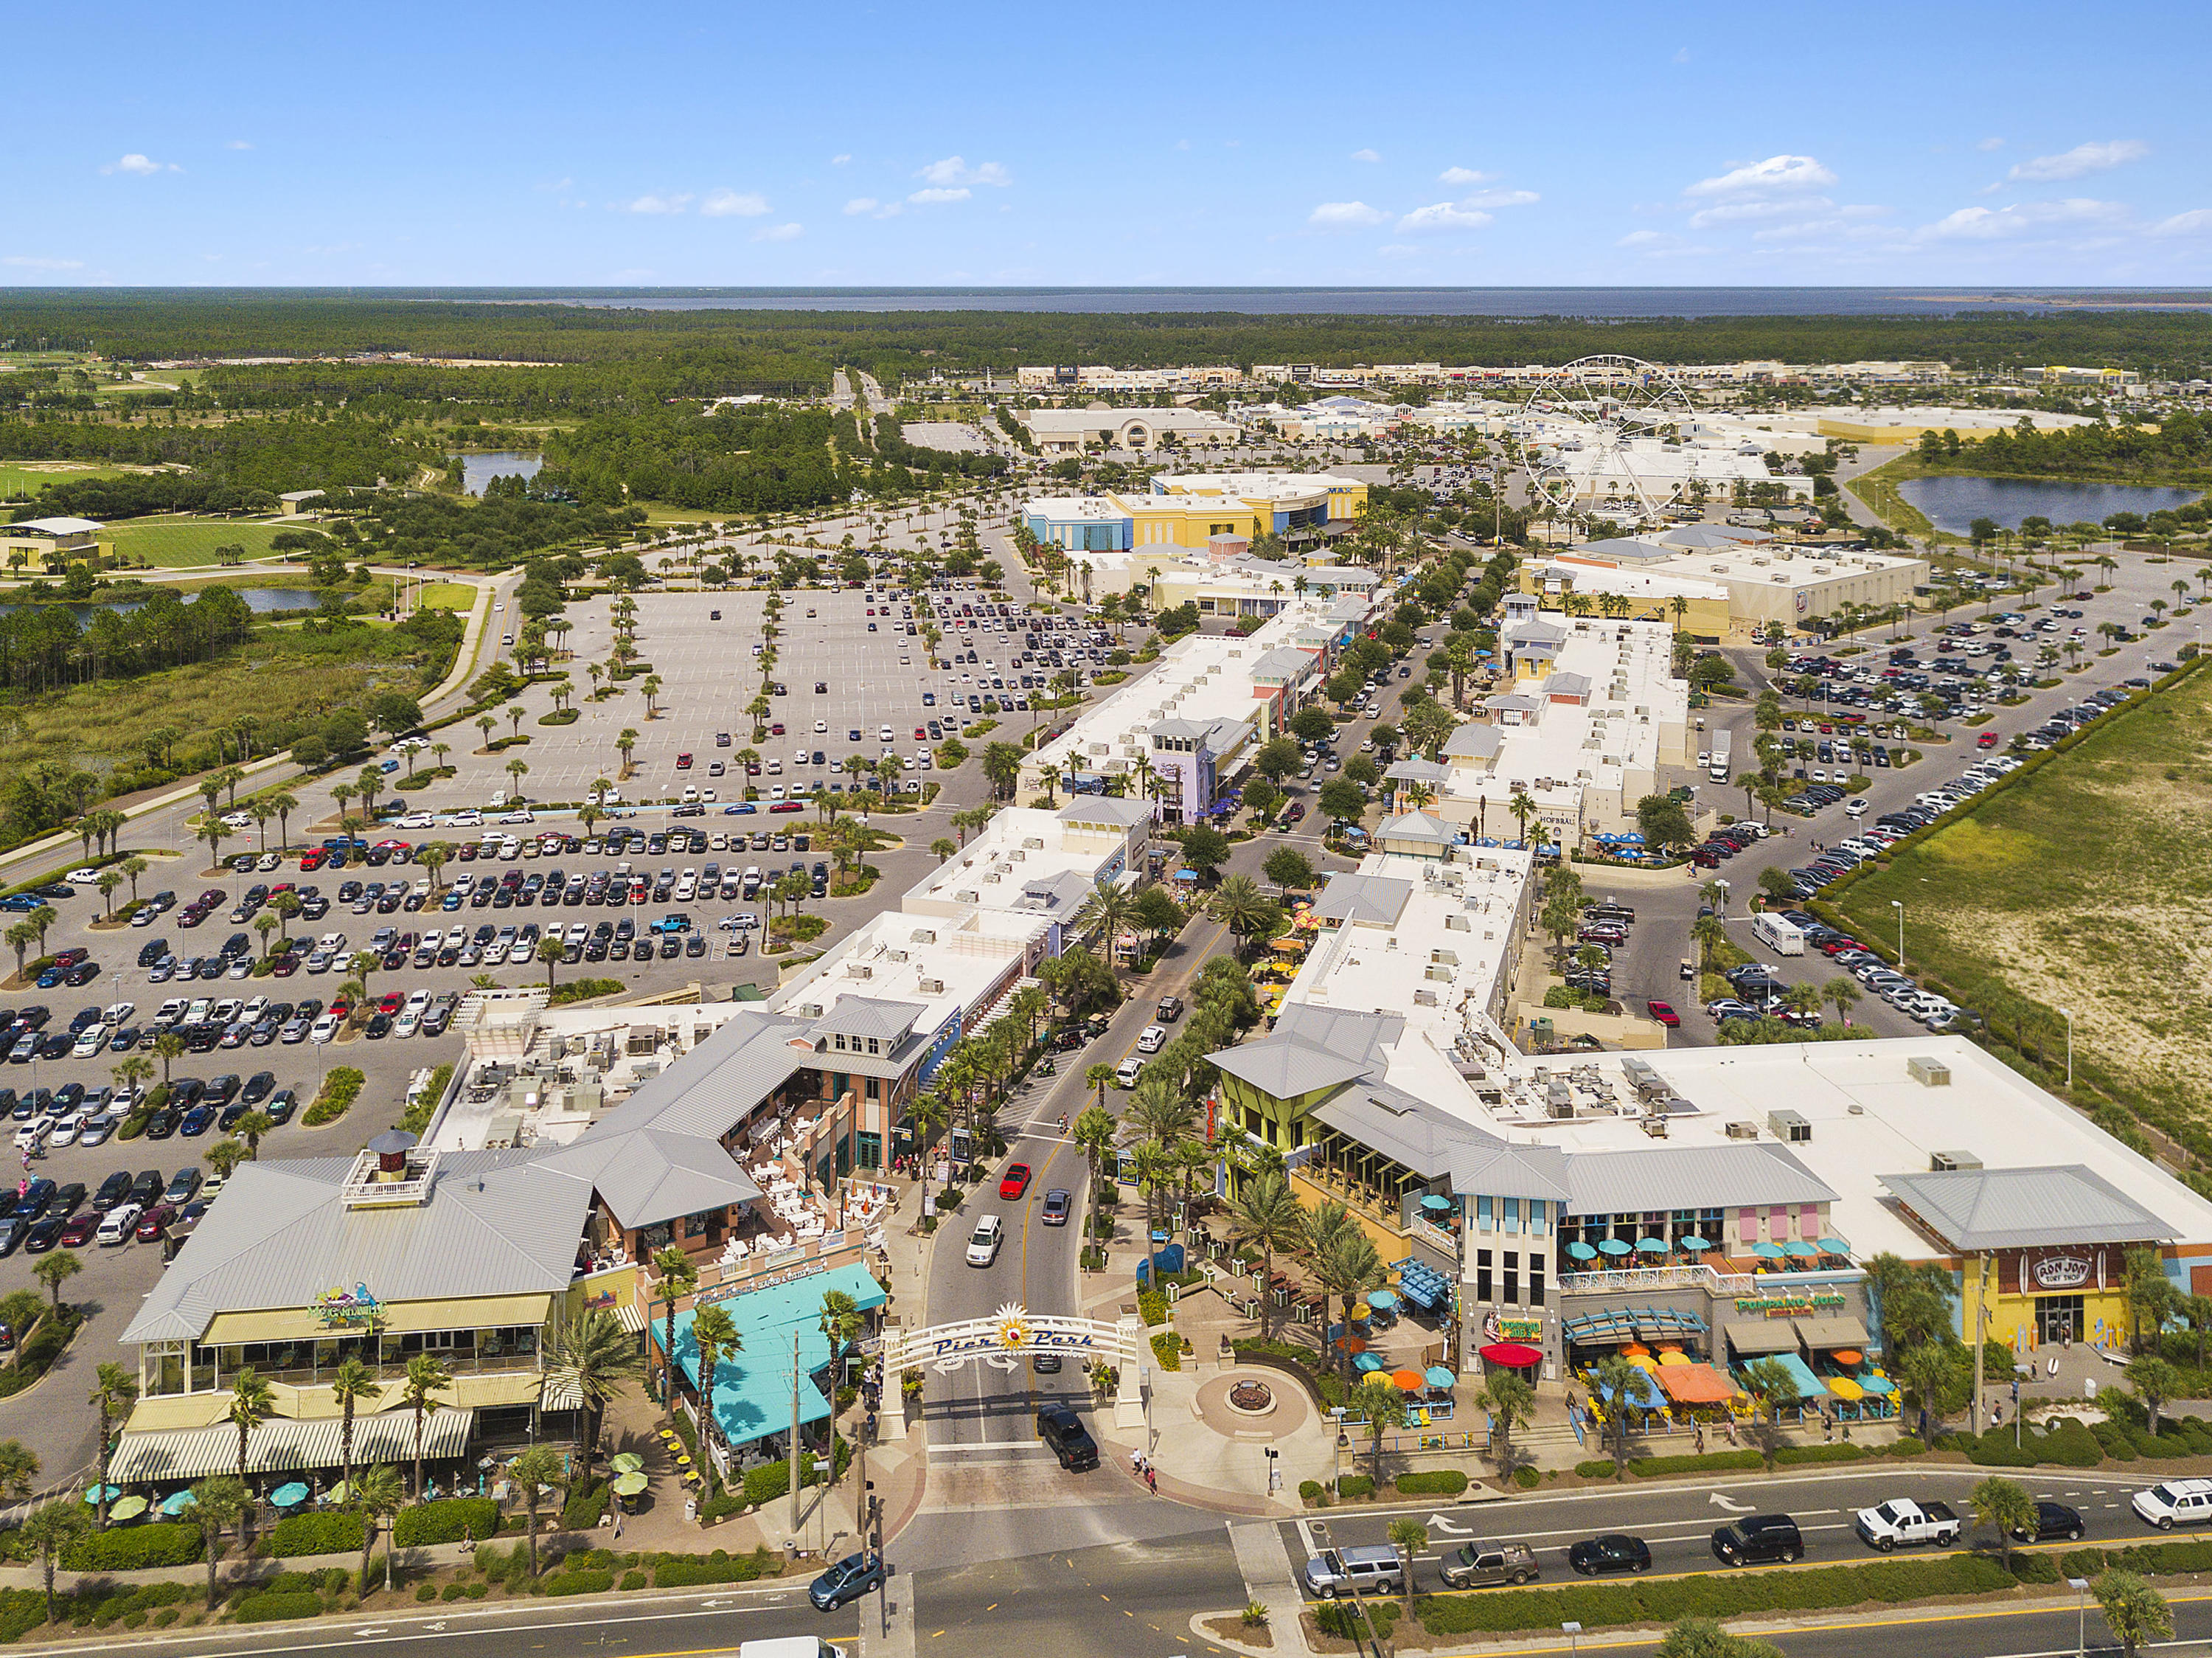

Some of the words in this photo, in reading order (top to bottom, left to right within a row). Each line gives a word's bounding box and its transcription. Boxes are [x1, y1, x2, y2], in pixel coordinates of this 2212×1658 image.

[2039, 1262, 2062, 1277] RON
[2064, 1262, 2087, 1274] JON
[2045, 1274, 2062, 1283] SURF
[2063, 1274, 2081, 1282] SHOP
[1736, 1297, 1806, 1310] POMPANO
[1501, 1320, 1540, 1333] POMPANO
[933, 1338, 996, 1356] Pier
[1032, 1330, 1099, 1348] Park
